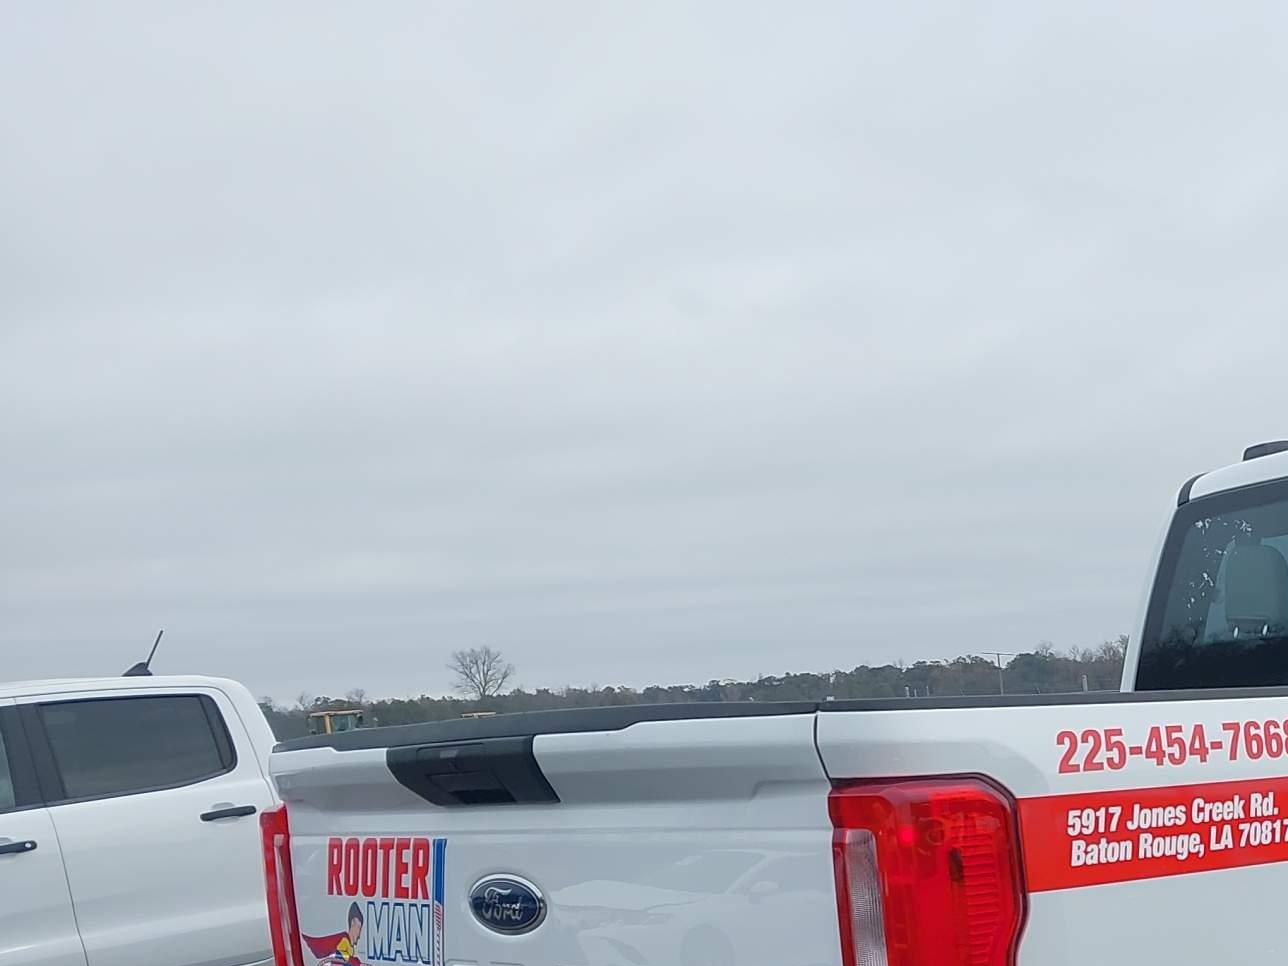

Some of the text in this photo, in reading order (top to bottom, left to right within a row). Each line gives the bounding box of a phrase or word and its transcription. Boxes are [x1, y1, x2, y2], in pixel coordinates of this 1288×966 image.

[1066, 791, 1279, 837] 5917 Jones Creek Rd.
[327, 837, 430, 900] ROOTER
[1070, 836, 1133, 868] Baton
[1139, 831, 1205, 859] Rouge,
[1210, 825, 1233, 851] LA
[482, 886, 528, 921] Ford
[366, 901, 431, 965] MAN
